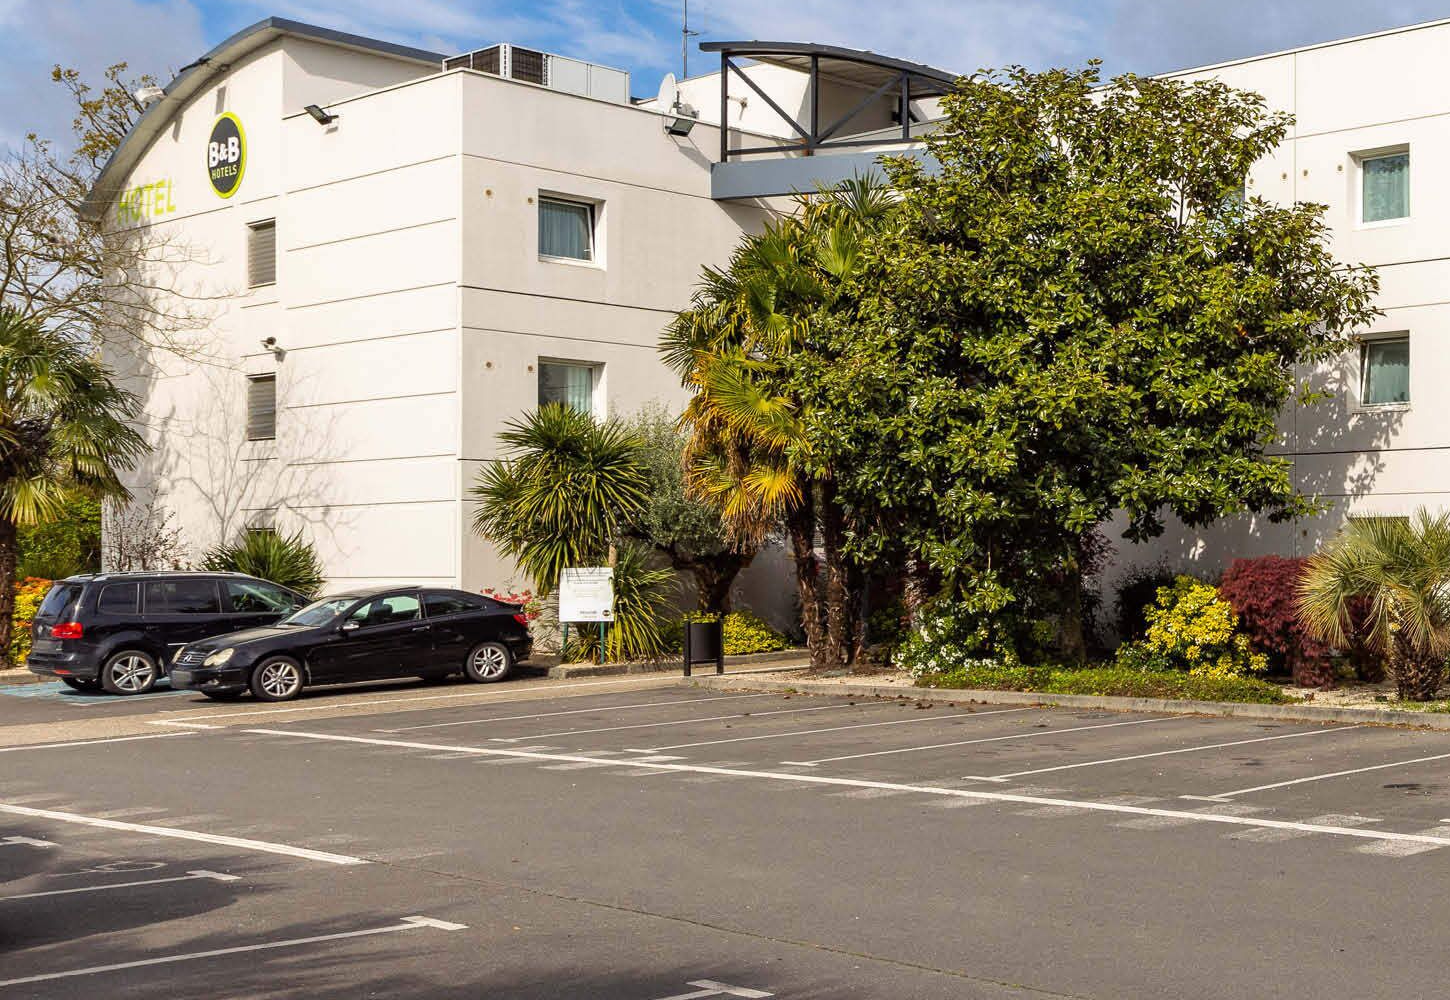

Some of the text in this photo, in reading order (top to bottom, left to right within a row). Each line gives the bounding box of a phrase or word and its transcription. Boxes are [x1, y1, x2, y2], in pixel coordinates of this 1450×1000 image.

[208, 137, 239, 167] B&B
[212, 165, 238, 179] HOTELS
[117, 178, 176, 225] HOTEL
